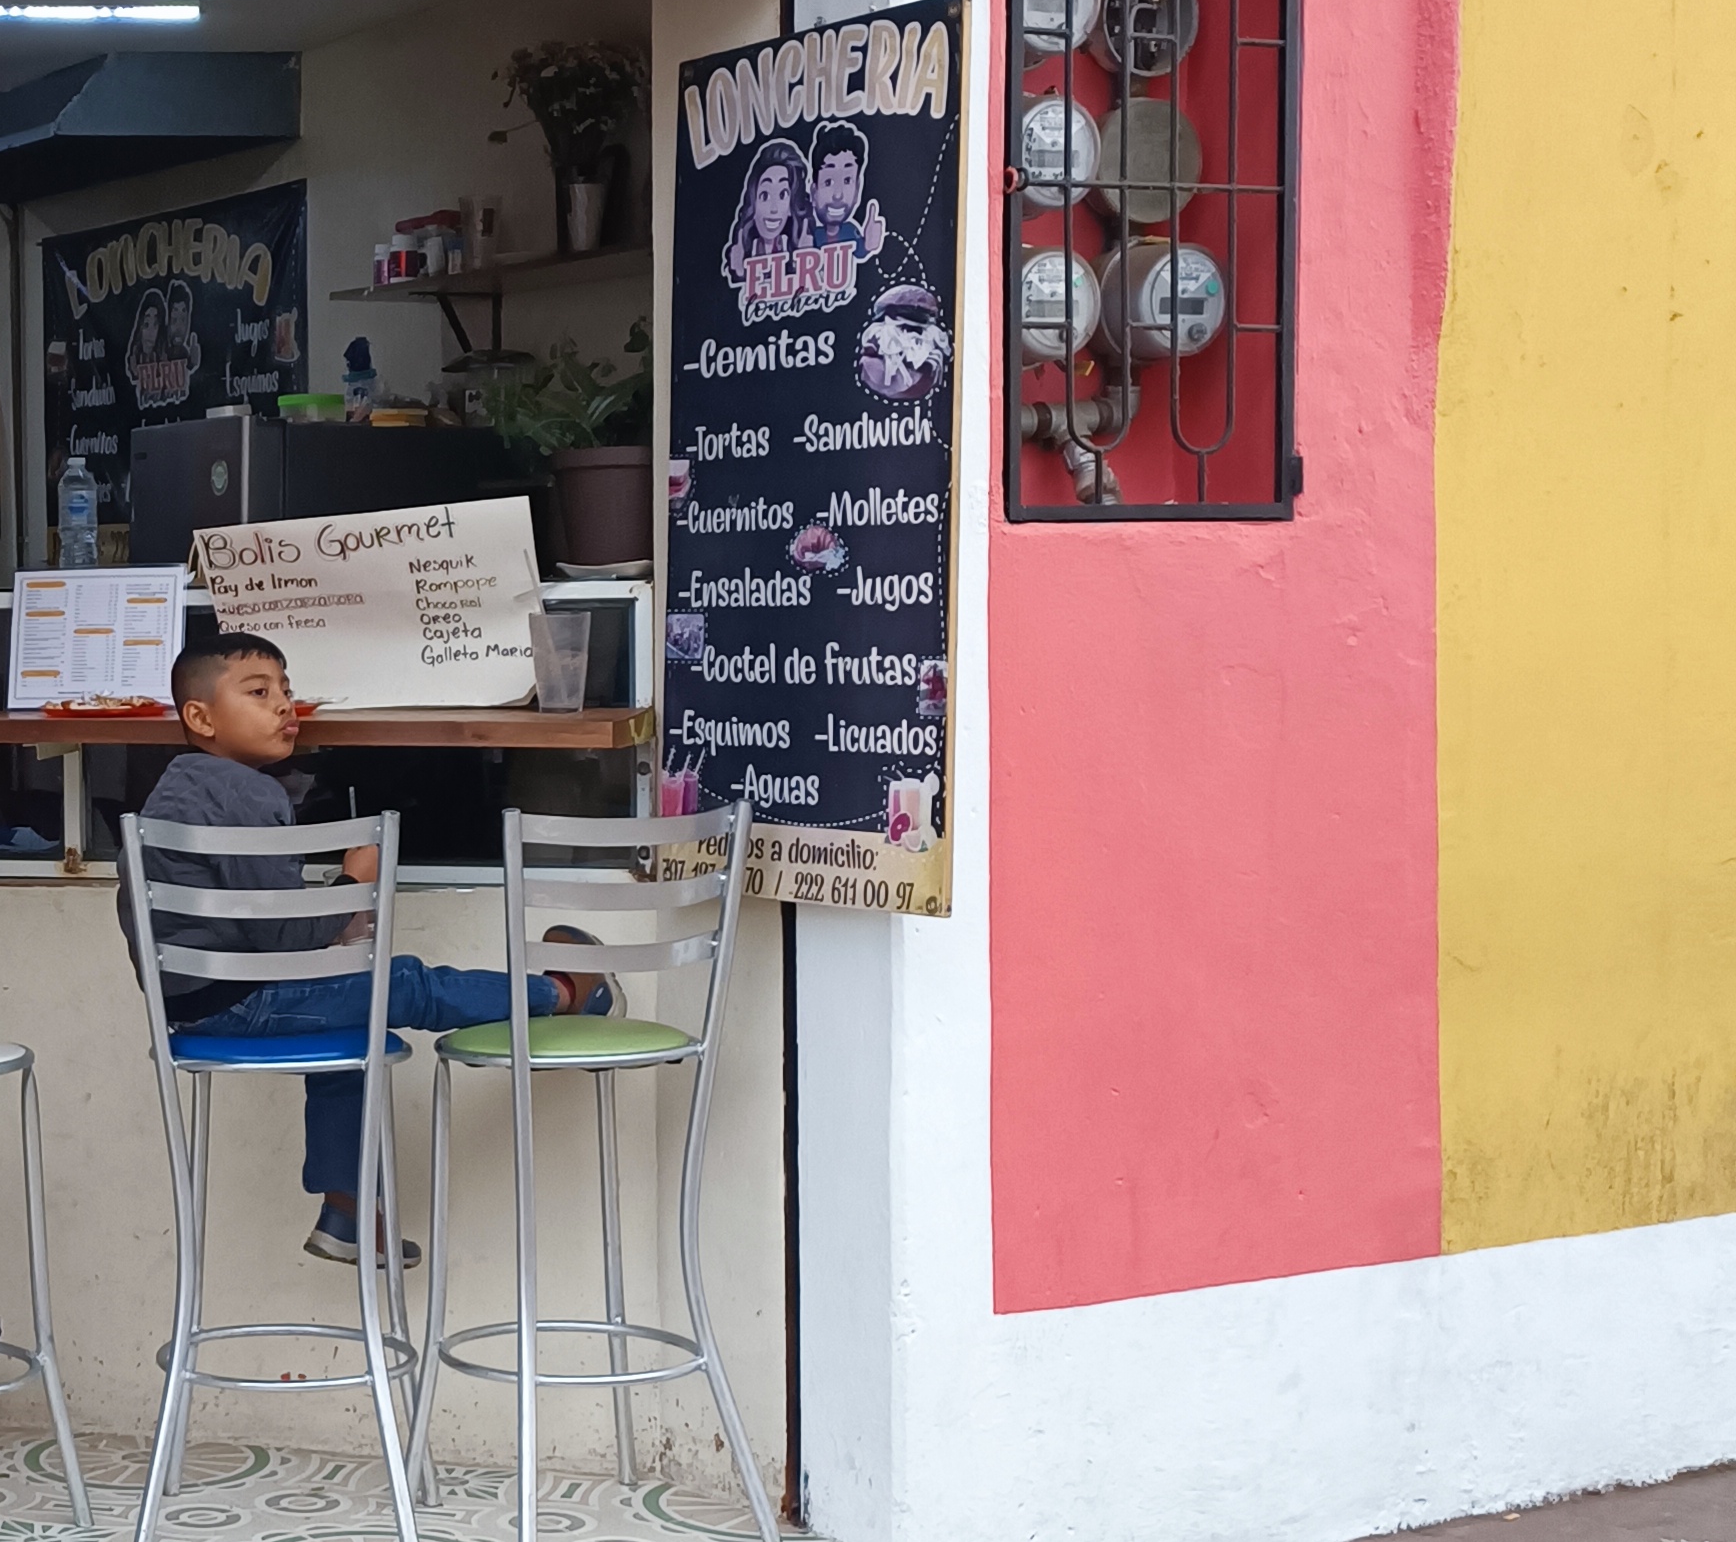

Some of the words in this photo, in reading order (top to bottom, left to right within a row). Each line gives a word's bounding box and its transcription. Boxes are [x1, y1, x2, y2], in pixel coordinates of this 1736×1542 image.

[684, 20, 949, 170] LONCHERIA
[64, 218, 272, 319] LONCHERIA
[744, 241, 856, 302] ELRU
[743, 286, 852, 322] loncheria
[200, 530, 301, 569] Bolis
[409, 554, 477, 575] Nesquik
[209, 575, 238, 597] Pay
[245, 577, 265, 591] de
[271, 574, 318, 589] limon
[415, 577, 497, 594] Rompope
[220, 620, 261, 632] Queso
[264, 620, 284, 630] con
[420, 613, 461, 625] Oreo
[784, 646, 816, 684] de
[826, 642, 917, 687] frutas
[771, 840, 782, 861] a
[788, 837, 879, 870] domicilio:
[794, 871, 824, 902] 222
[831, 876, 856, 905] 611
[864, 879, 889, 908] 00
[896, 882, 914, 909] 97
